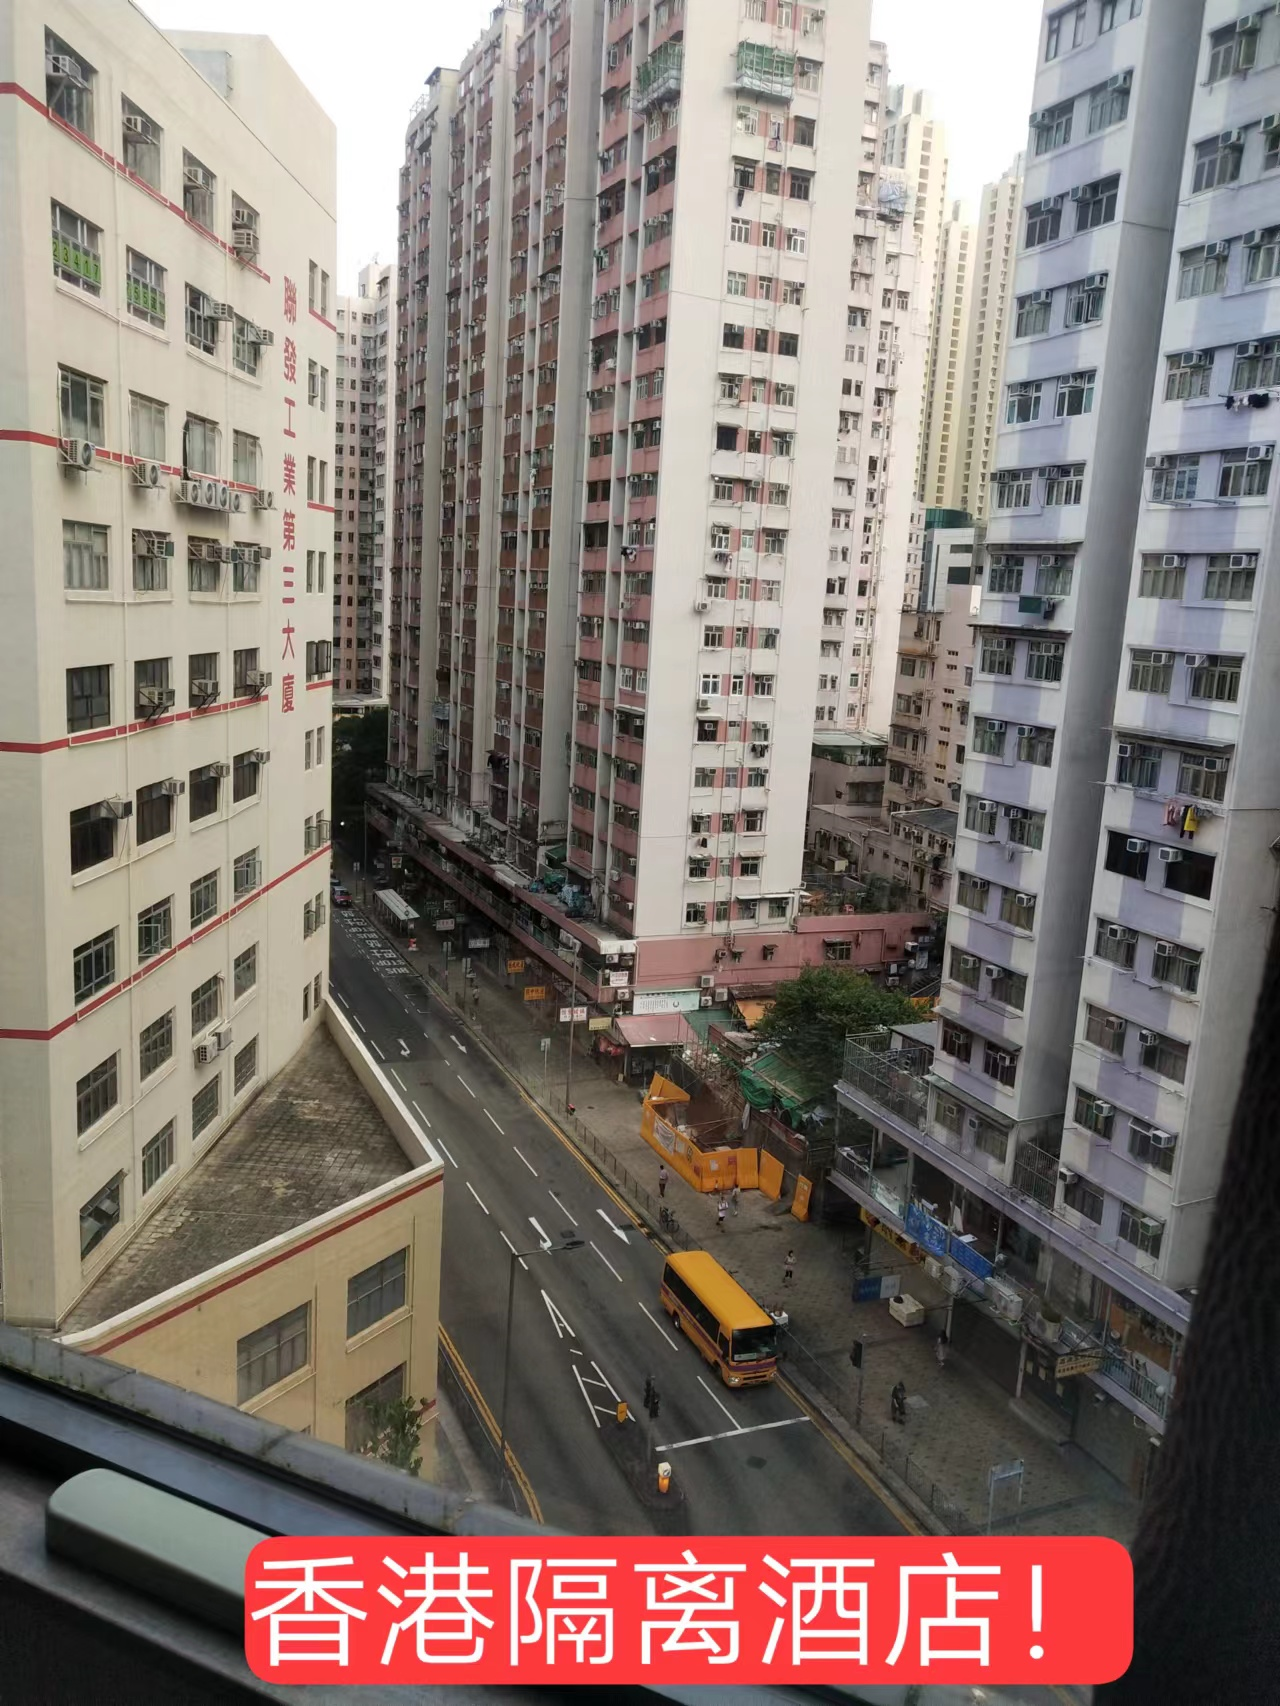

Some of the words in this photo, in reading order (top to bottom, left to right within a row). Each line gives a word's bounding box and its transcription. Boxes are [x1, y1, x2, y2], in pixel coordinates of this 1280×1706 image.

[281, 276, 297, 713] 聯發工業第三大廈
